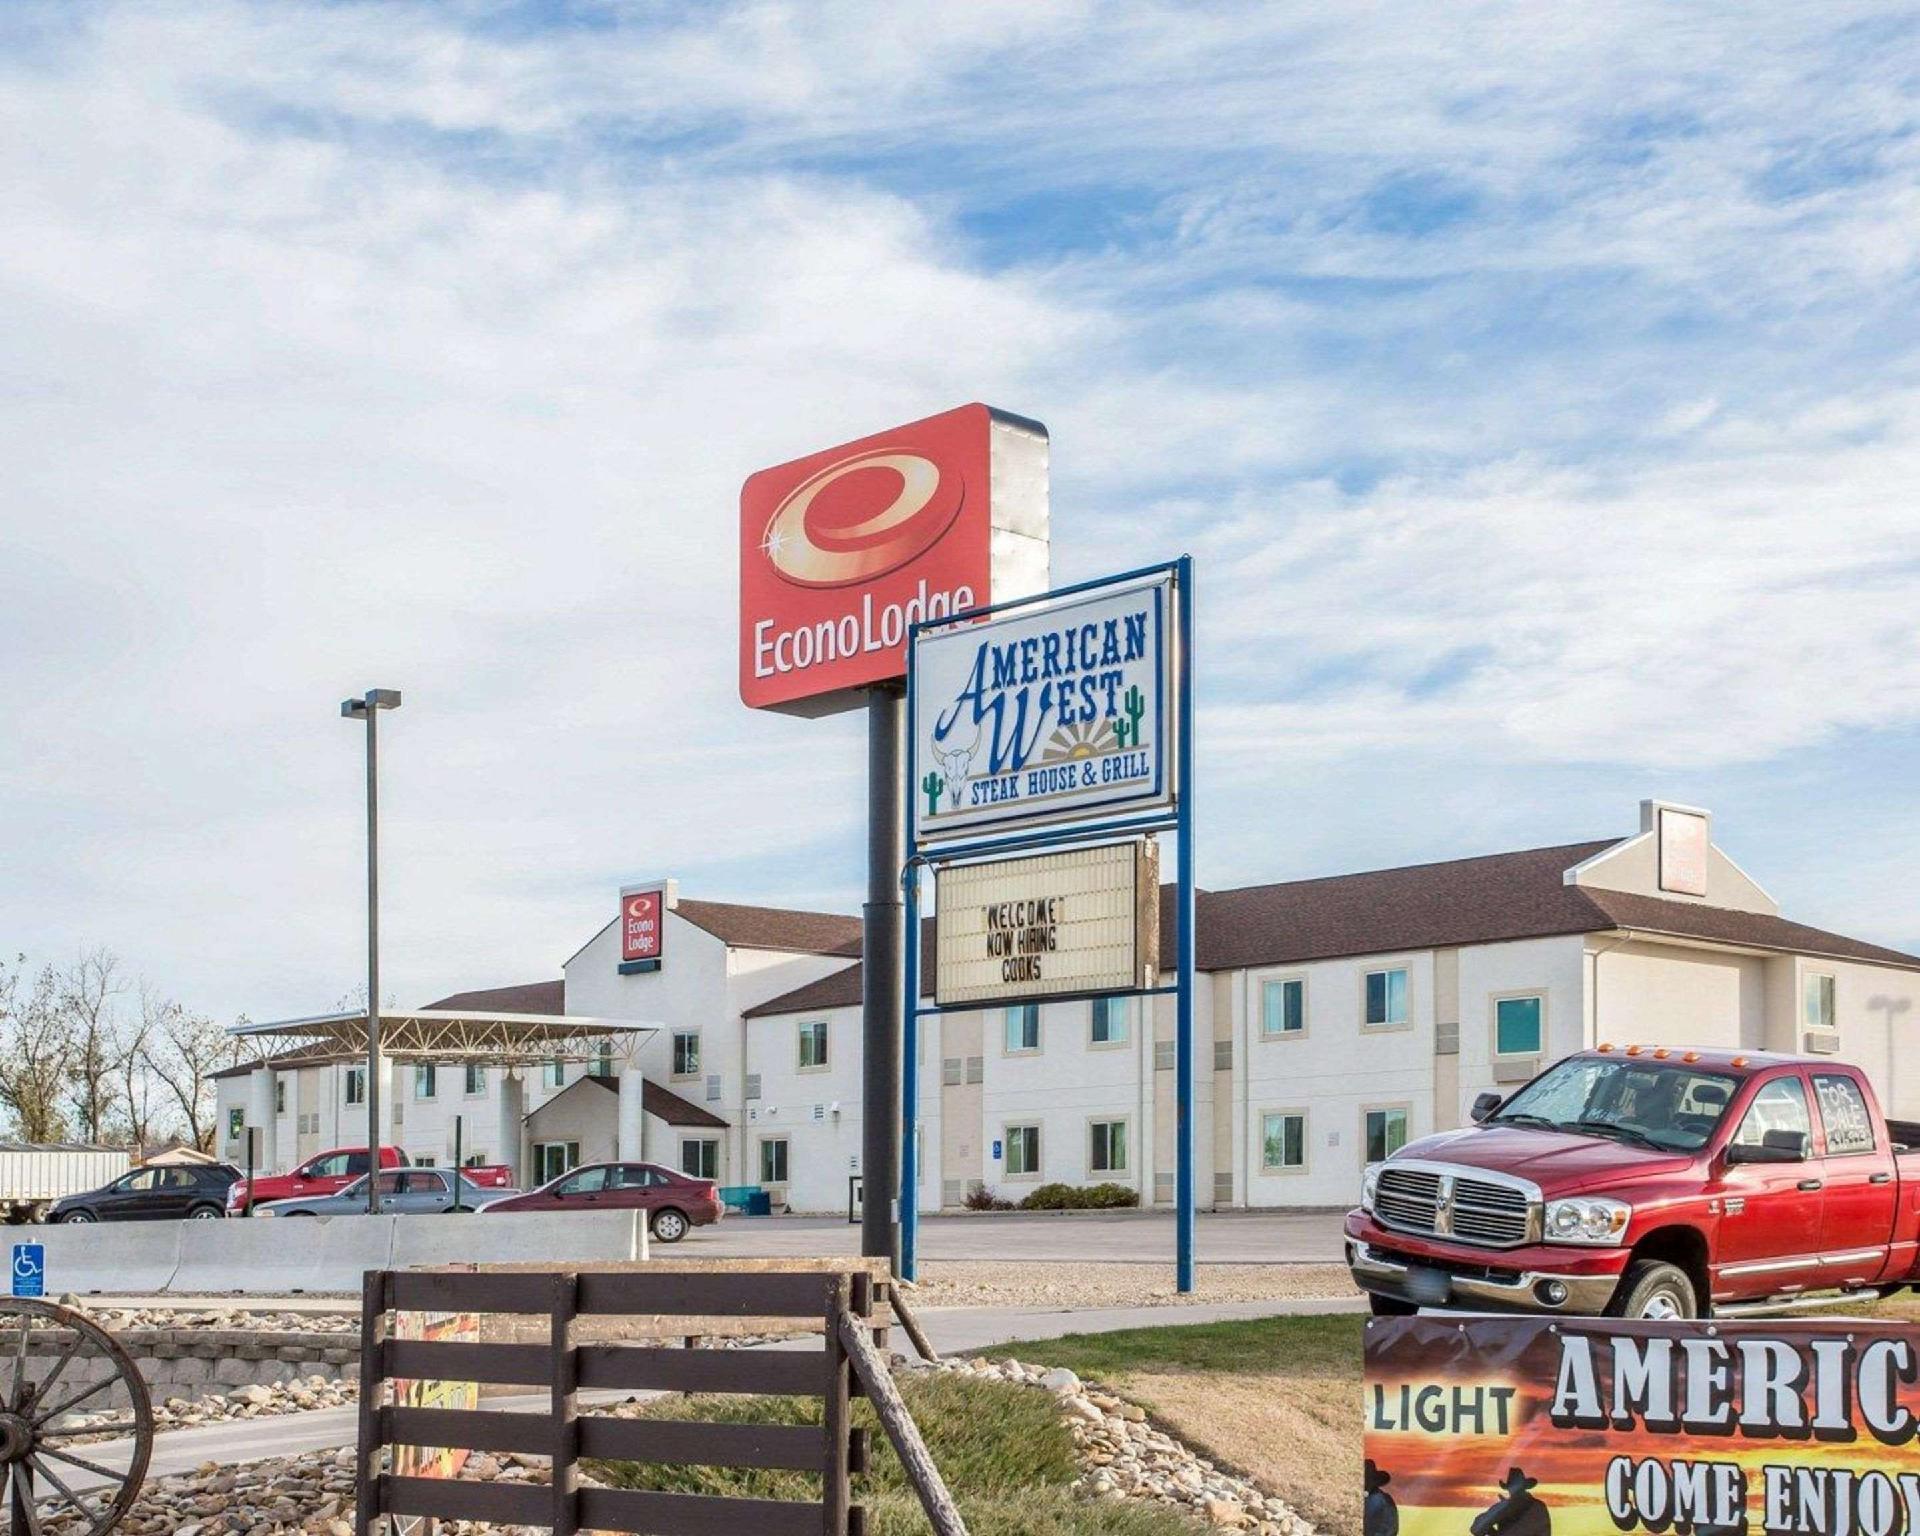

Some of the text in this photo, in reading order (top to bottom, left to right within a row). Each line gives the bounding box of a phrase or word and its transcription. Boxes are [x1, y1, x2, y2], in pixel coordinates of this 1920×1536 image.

[934, 611, 1147, 741] AMERICAN
[987, 670, 1122, 775] WEST
[971, 752, 1150, 805] STEAK HOUSE & GRILL
[628, 919, 654, 934] Econo
[628, 934, 654, 952] Lodge
[986, 927, 1056, 957] NOW HIRING
[1002, 955, 1041, 983] COOKS
[1814, 1078, 1854, 1107] FOR
[1823, 1104, 1866, 1132] SALE
[1551, 1335, 1920, 1442] AMERIC
[1374, 1384, 1516, 1435] LIGHT
[1605, 1456, 1749, 1532] COME
